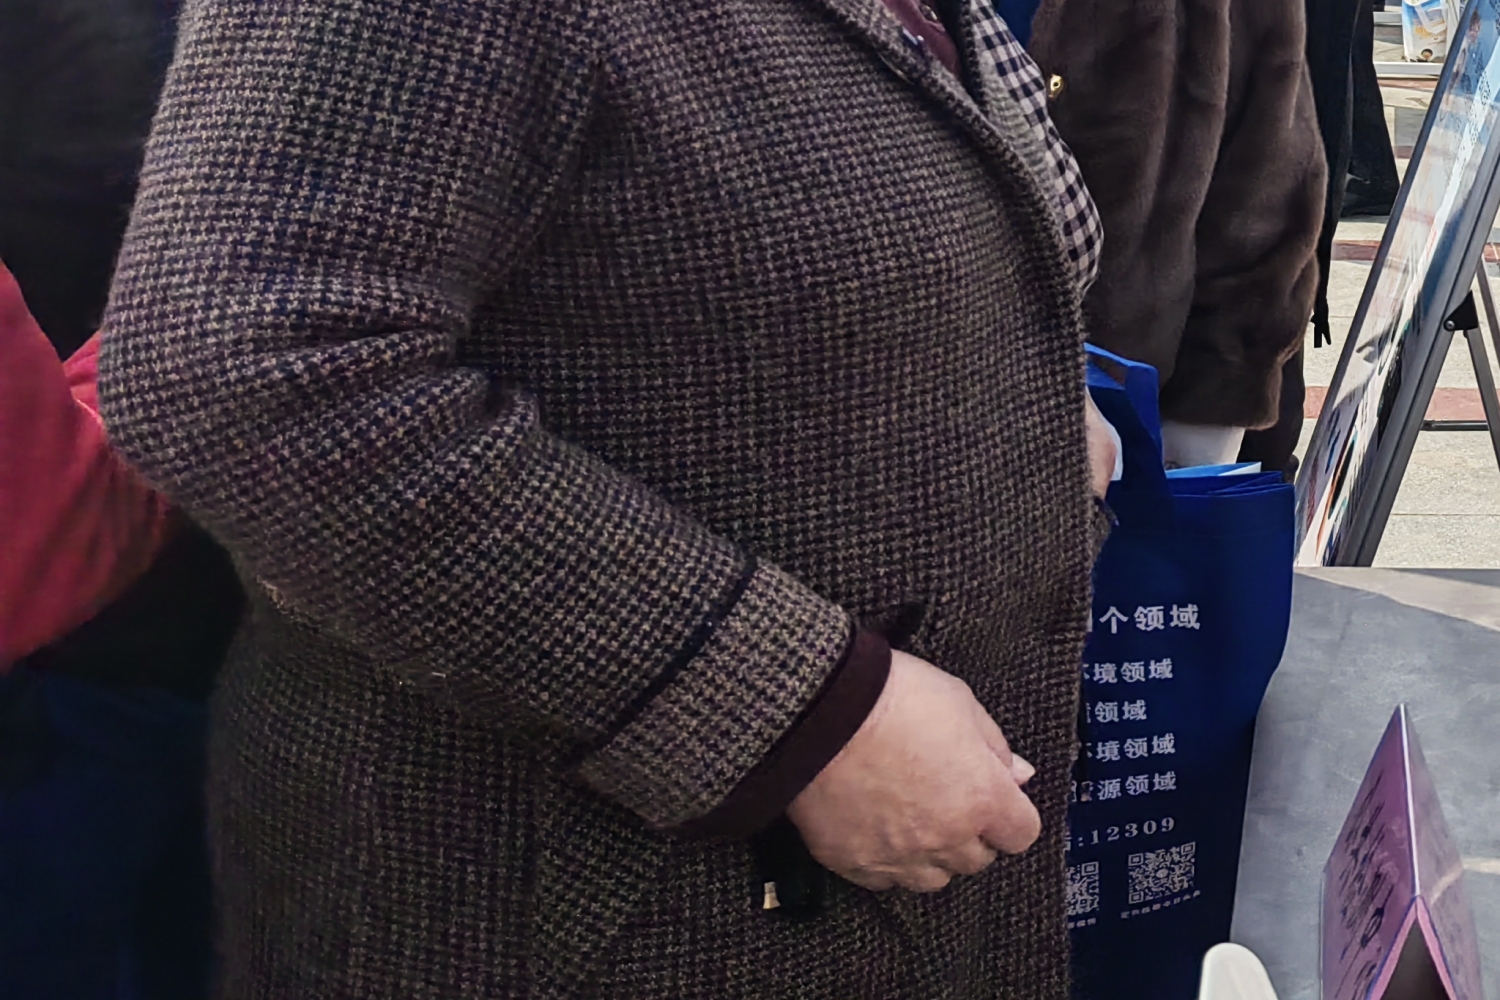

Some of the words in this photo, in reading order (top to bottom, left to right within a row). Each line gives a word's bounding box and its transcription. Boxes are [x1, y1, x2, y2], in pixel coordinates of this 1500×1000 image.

[1087, 603, 1201, 634] 个领域
[1086, 699, 1147, 723] 领域
